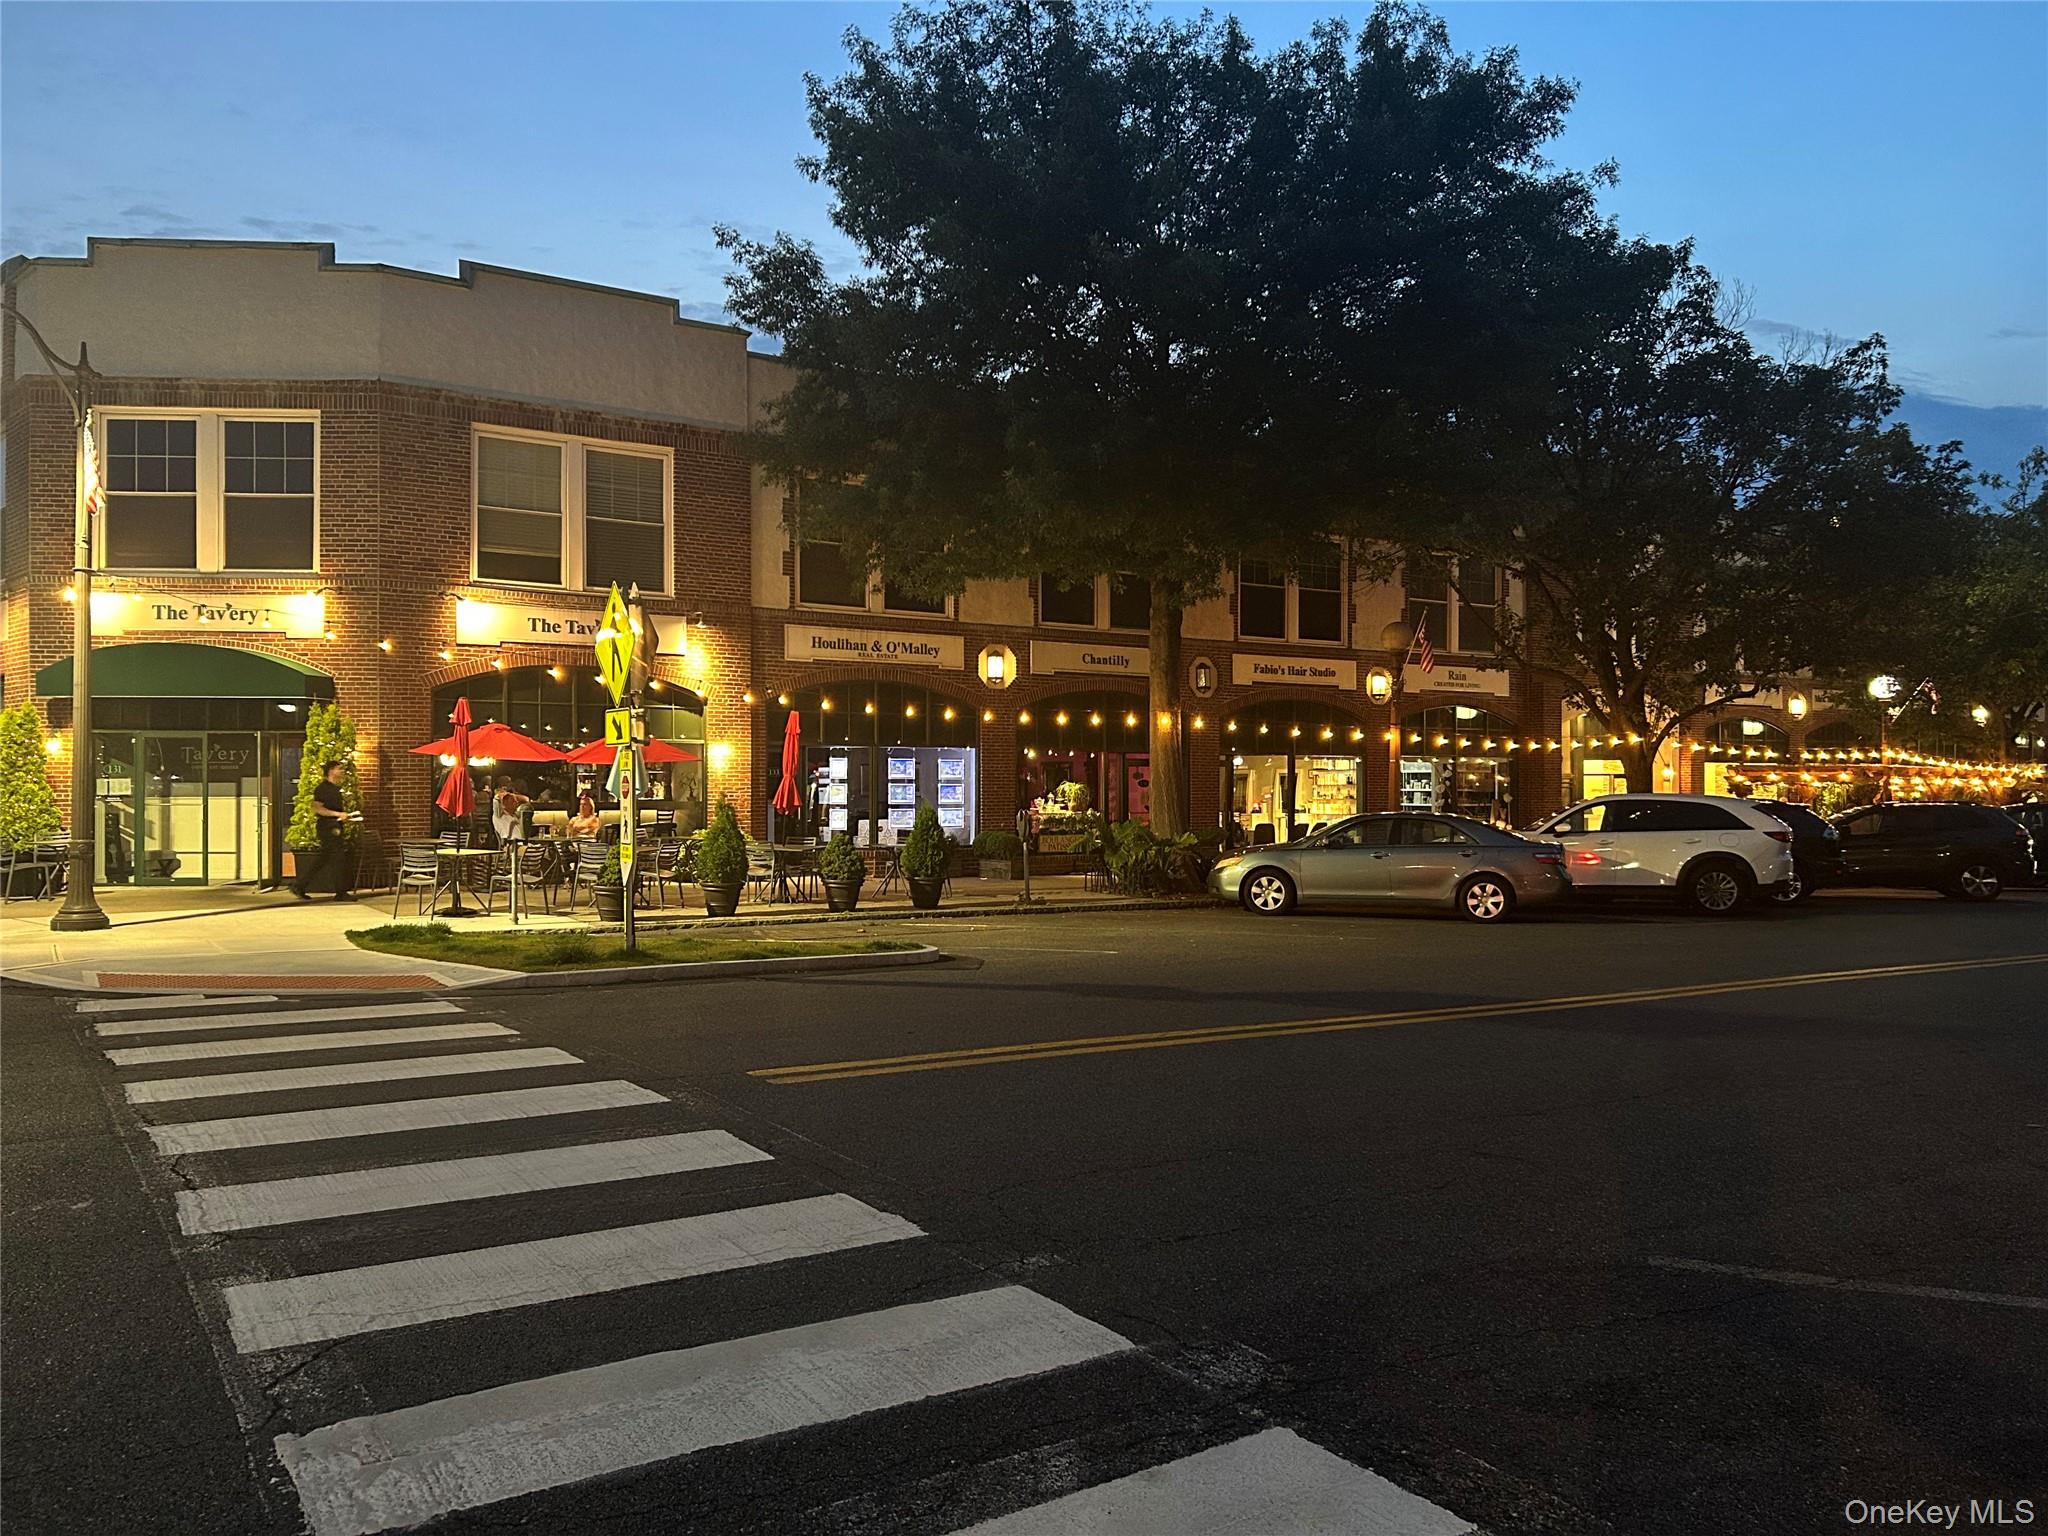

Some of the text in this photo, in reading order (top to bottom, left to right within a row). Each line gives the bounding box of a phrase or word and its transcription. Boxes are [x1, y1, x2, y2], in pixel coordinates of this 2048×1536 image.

[152, 604, 188, 620] The
[527, 617, 562, 633] The
[811, 636, 940, 658] Houlihan & O'Malley
[1082, 653, 1130, 668] Chantilly
[1253, 663, 1336, 677] Fabio's Hair Studio
[1448, 670, 1467, 681] Rain
[108, 765, 122, 774] 131
